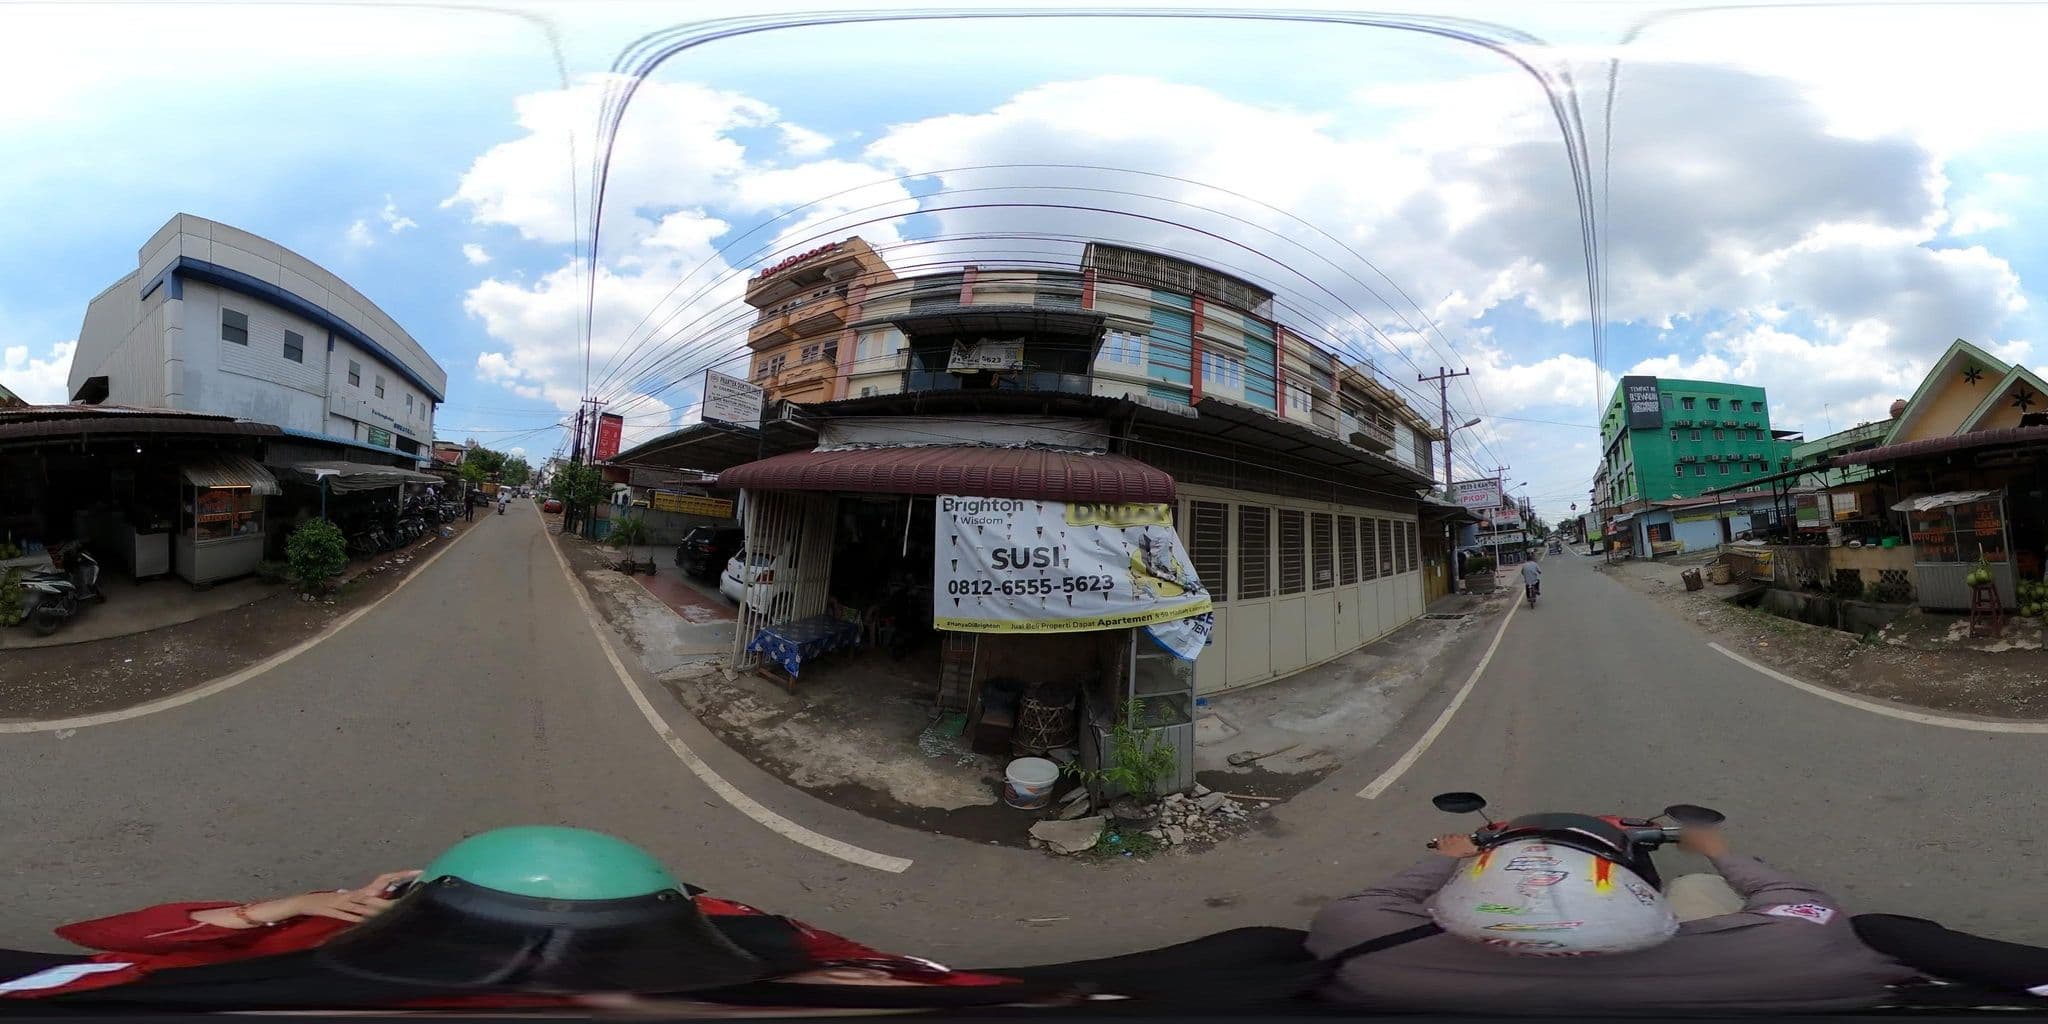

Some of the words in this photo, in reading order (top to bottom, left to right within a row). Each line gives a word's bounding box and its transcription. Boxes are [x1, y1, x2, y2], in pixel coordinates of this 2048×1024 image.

[943, 498, 1024, 515] Brighton
[961, 516, 1003, 525] Wisdom
[991, 547, 1060, 570] SUSI
[947, 575, 1115, 595] 0812-6555-5623
[1041, 620, 1071, 630] Properti
[1073, 618, 1095, 630] Dapat
[1097, 613, 1153, 629] Apartemen
